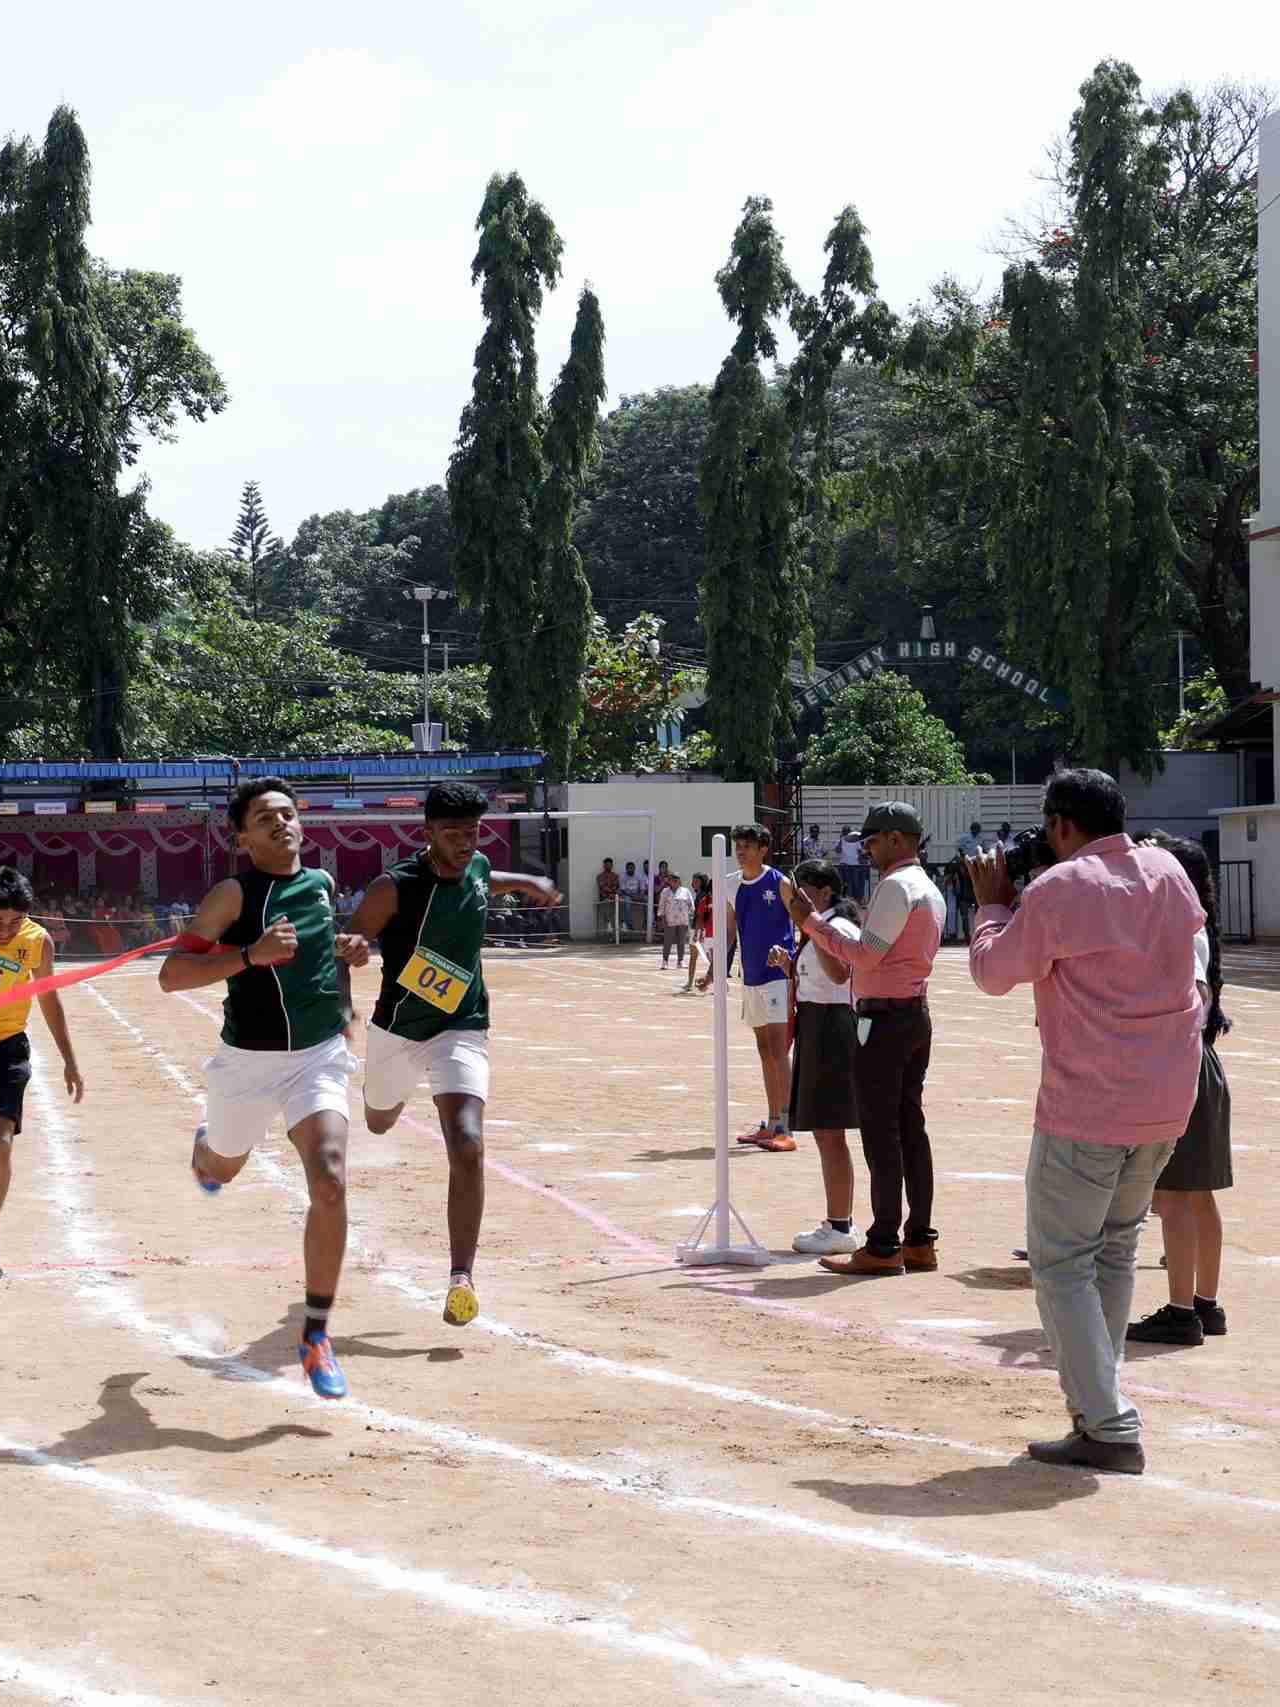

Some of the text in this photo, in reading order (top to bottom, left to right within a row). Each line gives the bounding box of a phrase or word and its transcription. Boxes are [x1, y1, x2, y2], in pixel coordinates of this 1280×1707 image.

[793, 641, 1050, 713] BETHANY HIGH SCHOOL
[418, 965, 453, 998] 04
